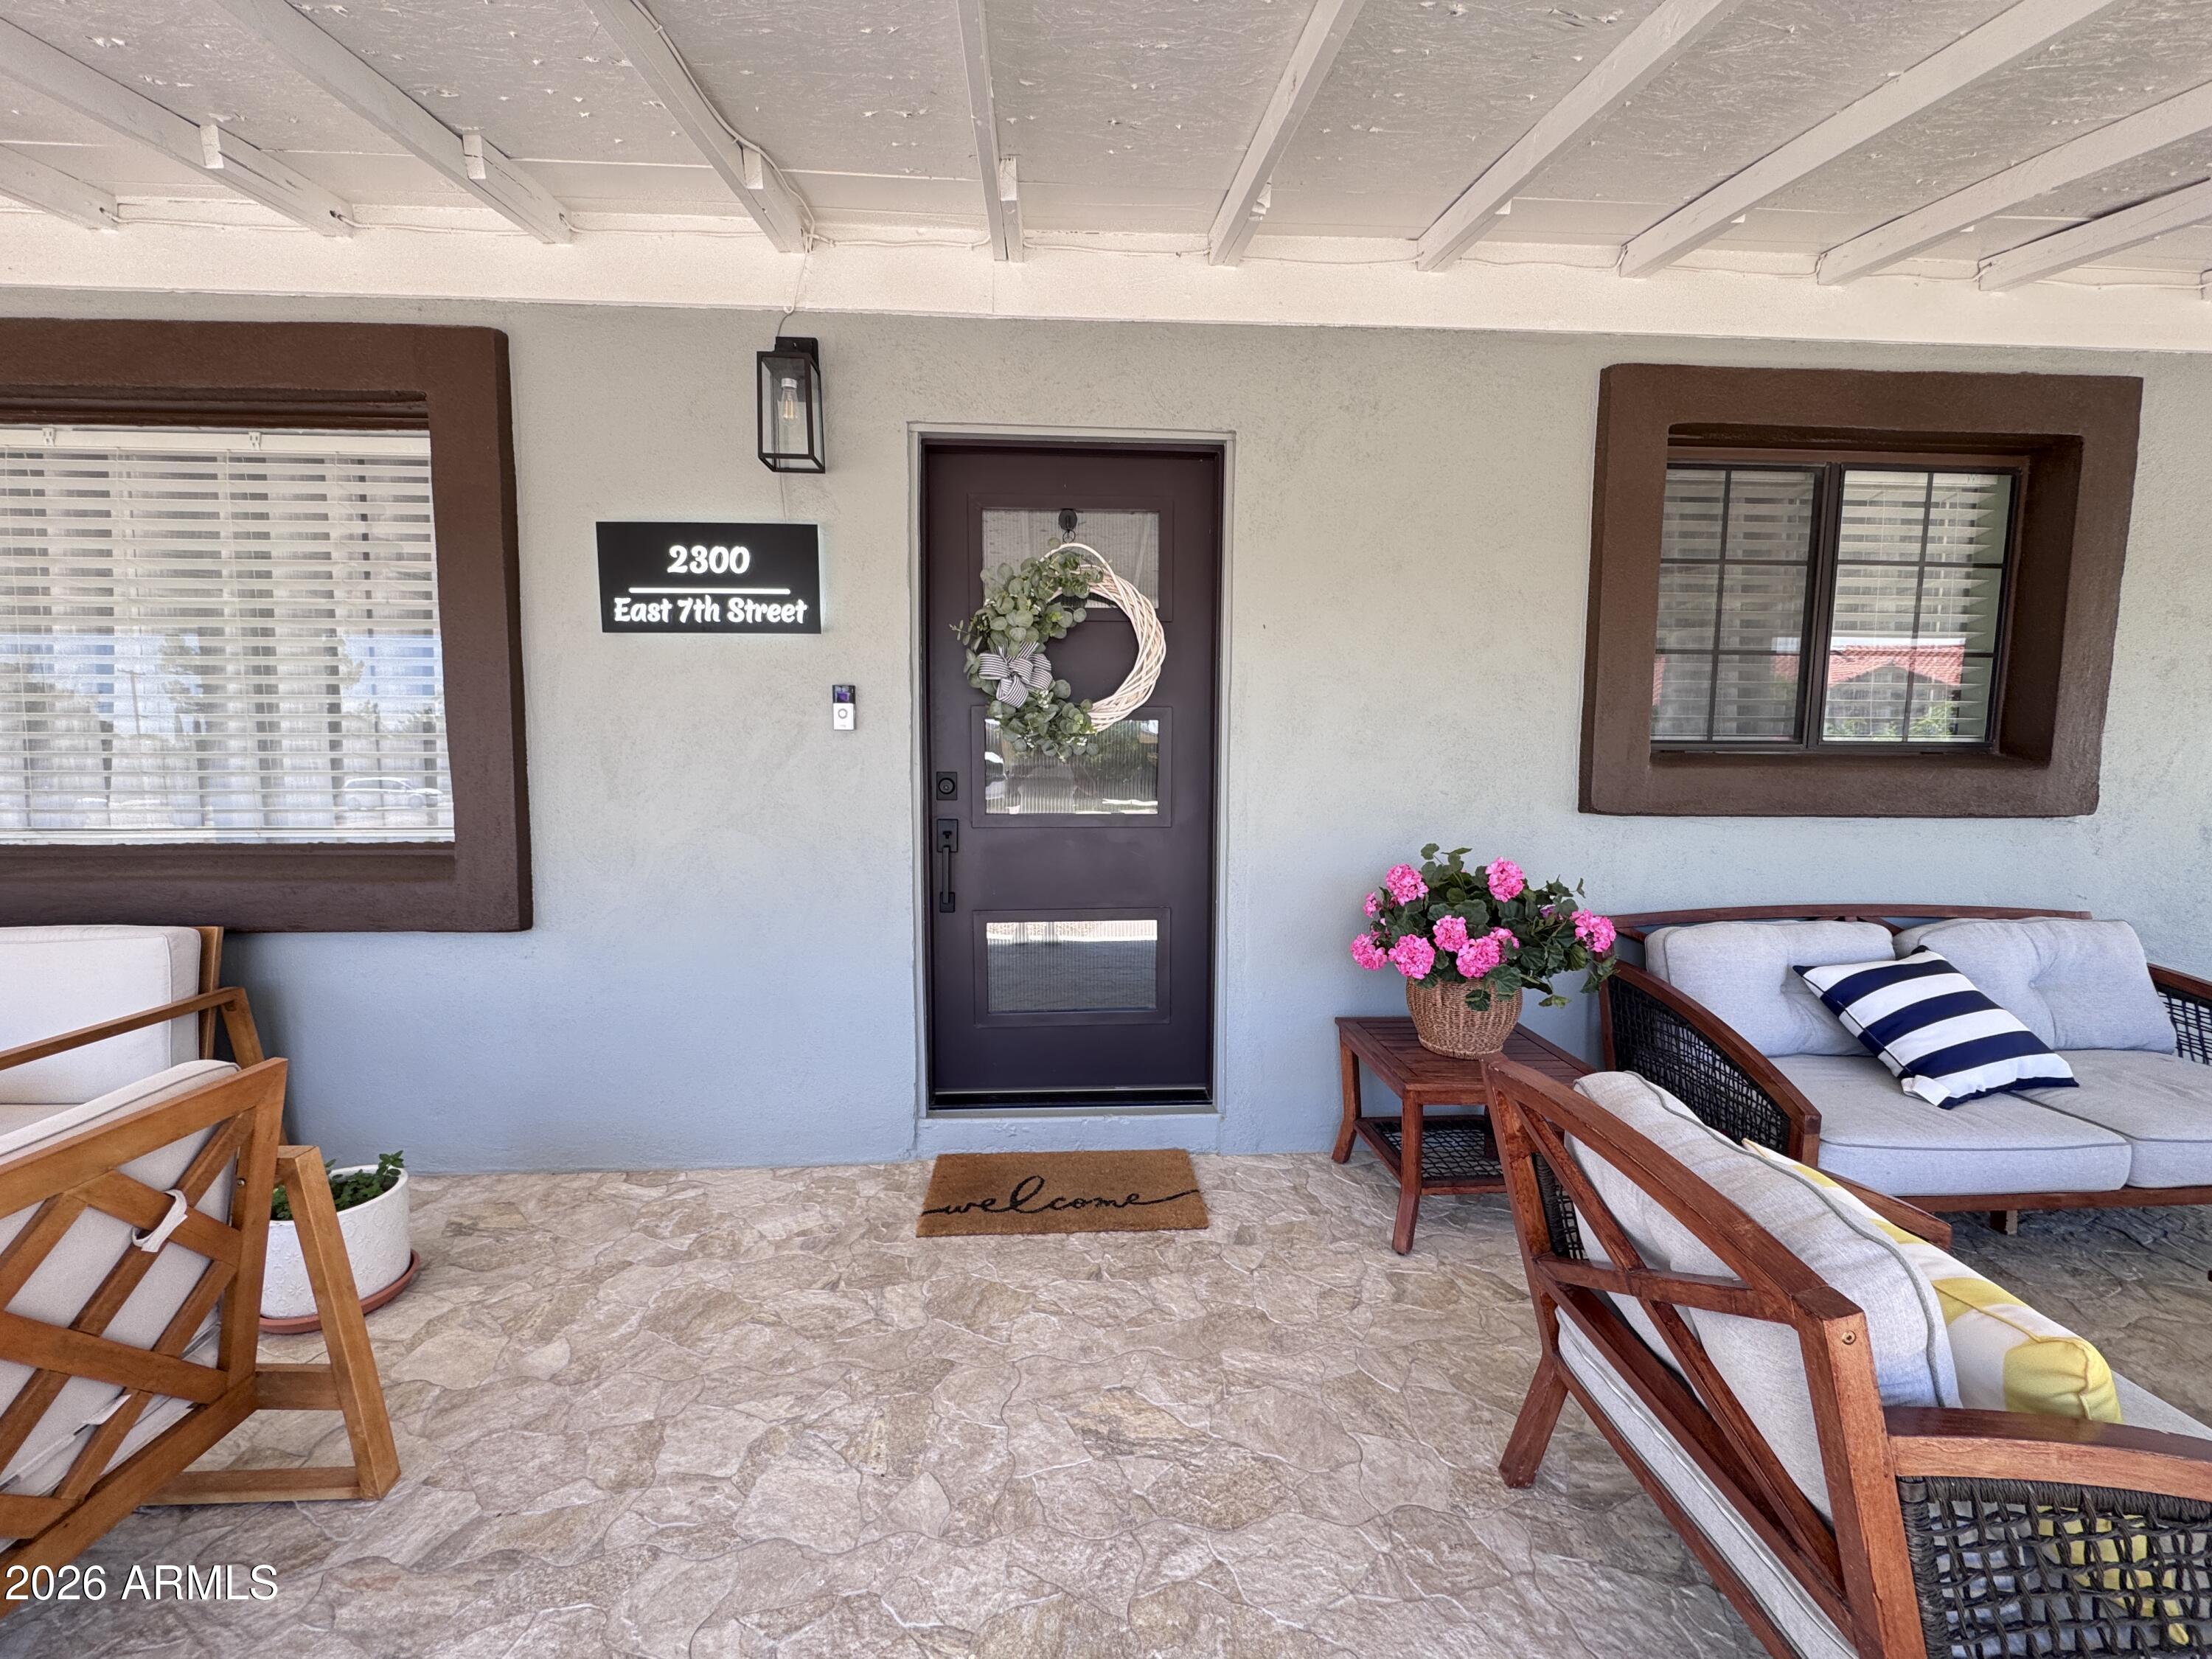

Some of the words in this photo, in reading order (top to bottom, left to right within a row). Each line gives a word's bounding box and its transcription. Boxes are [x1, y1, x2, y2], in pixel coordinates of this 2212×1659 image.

[667, 545, 750, 574] 2300
[614, 597, 672, 622] East
[677, 594, 720, 623] 7th
[726, 597, 808, 624] Street
[922, 1175, 1201, 1216] welcome
